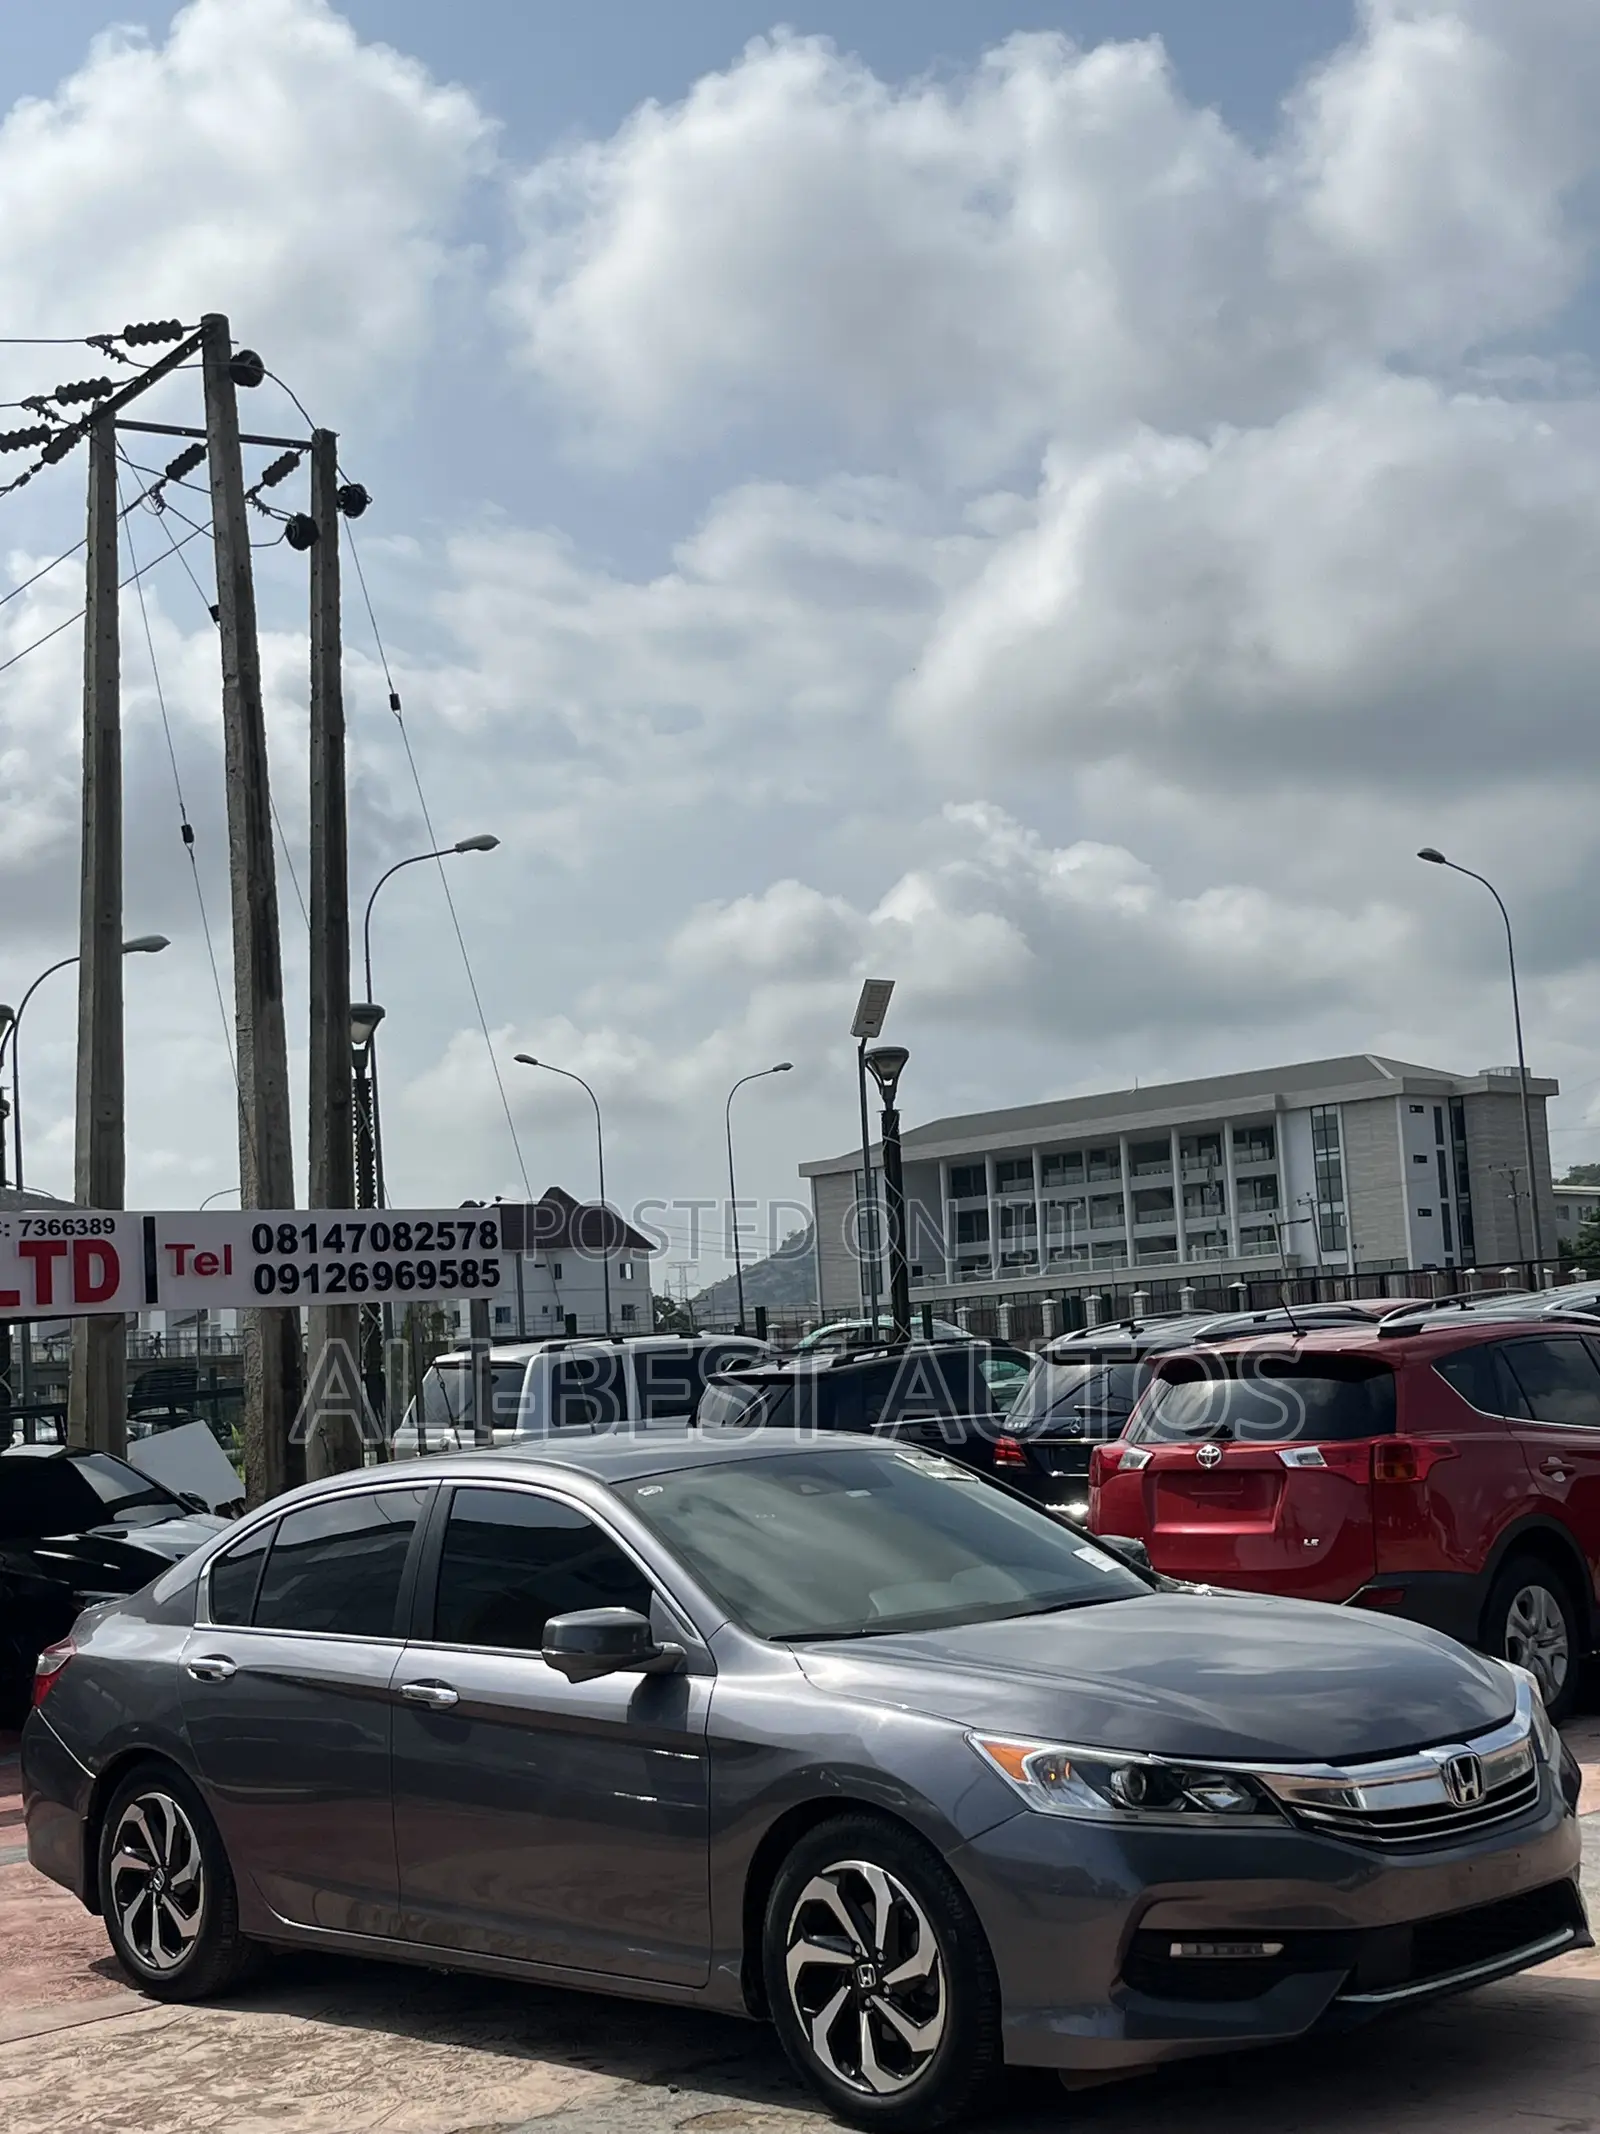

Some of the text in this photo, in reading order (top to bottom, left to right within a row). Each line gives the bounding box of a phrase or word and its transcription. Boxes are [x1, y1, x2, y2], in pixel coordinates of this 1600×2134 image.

[18, 1217, 116, 1237] 7366389
[252, 1220, 498, 1255] 08147082578
[164, 1243, 233, 1276] Tel
[254, 1258, 500, 1295] 09126969585
